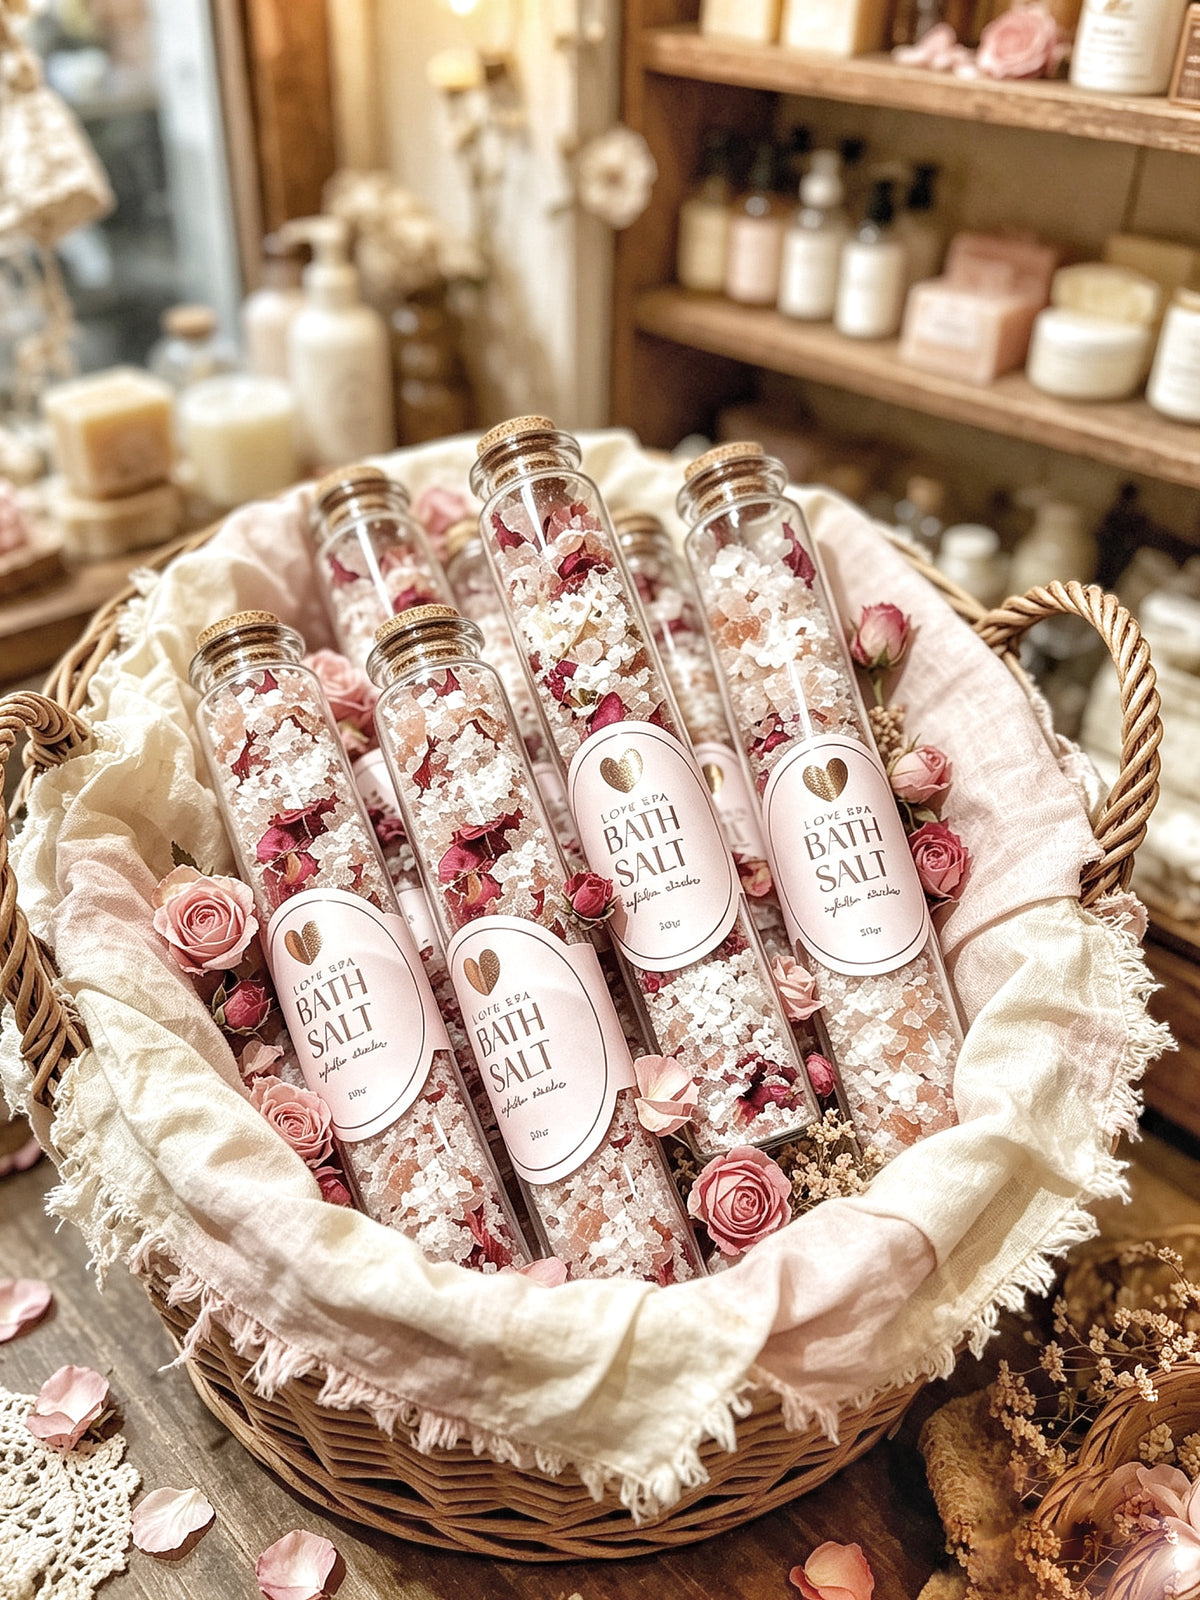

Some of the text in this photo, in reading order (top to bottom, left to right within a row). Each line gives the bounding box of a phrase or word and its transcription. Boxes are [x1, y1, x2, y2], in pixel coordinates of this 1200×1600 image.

[603, 804, 681, 856] BATH
[803, 816, 884, 861] BATH
[804, 810, 841, 830] LOVE
[614, 838, 687, 888] SALT
[815, 849, 888, 893] SALT
[295, 967, 369, 1027] BATH
[306, 1002, 374, 1060] SALT
[475, 1001, 546, 1059] BATH
[489, 1039, 553, 1093] SALT
